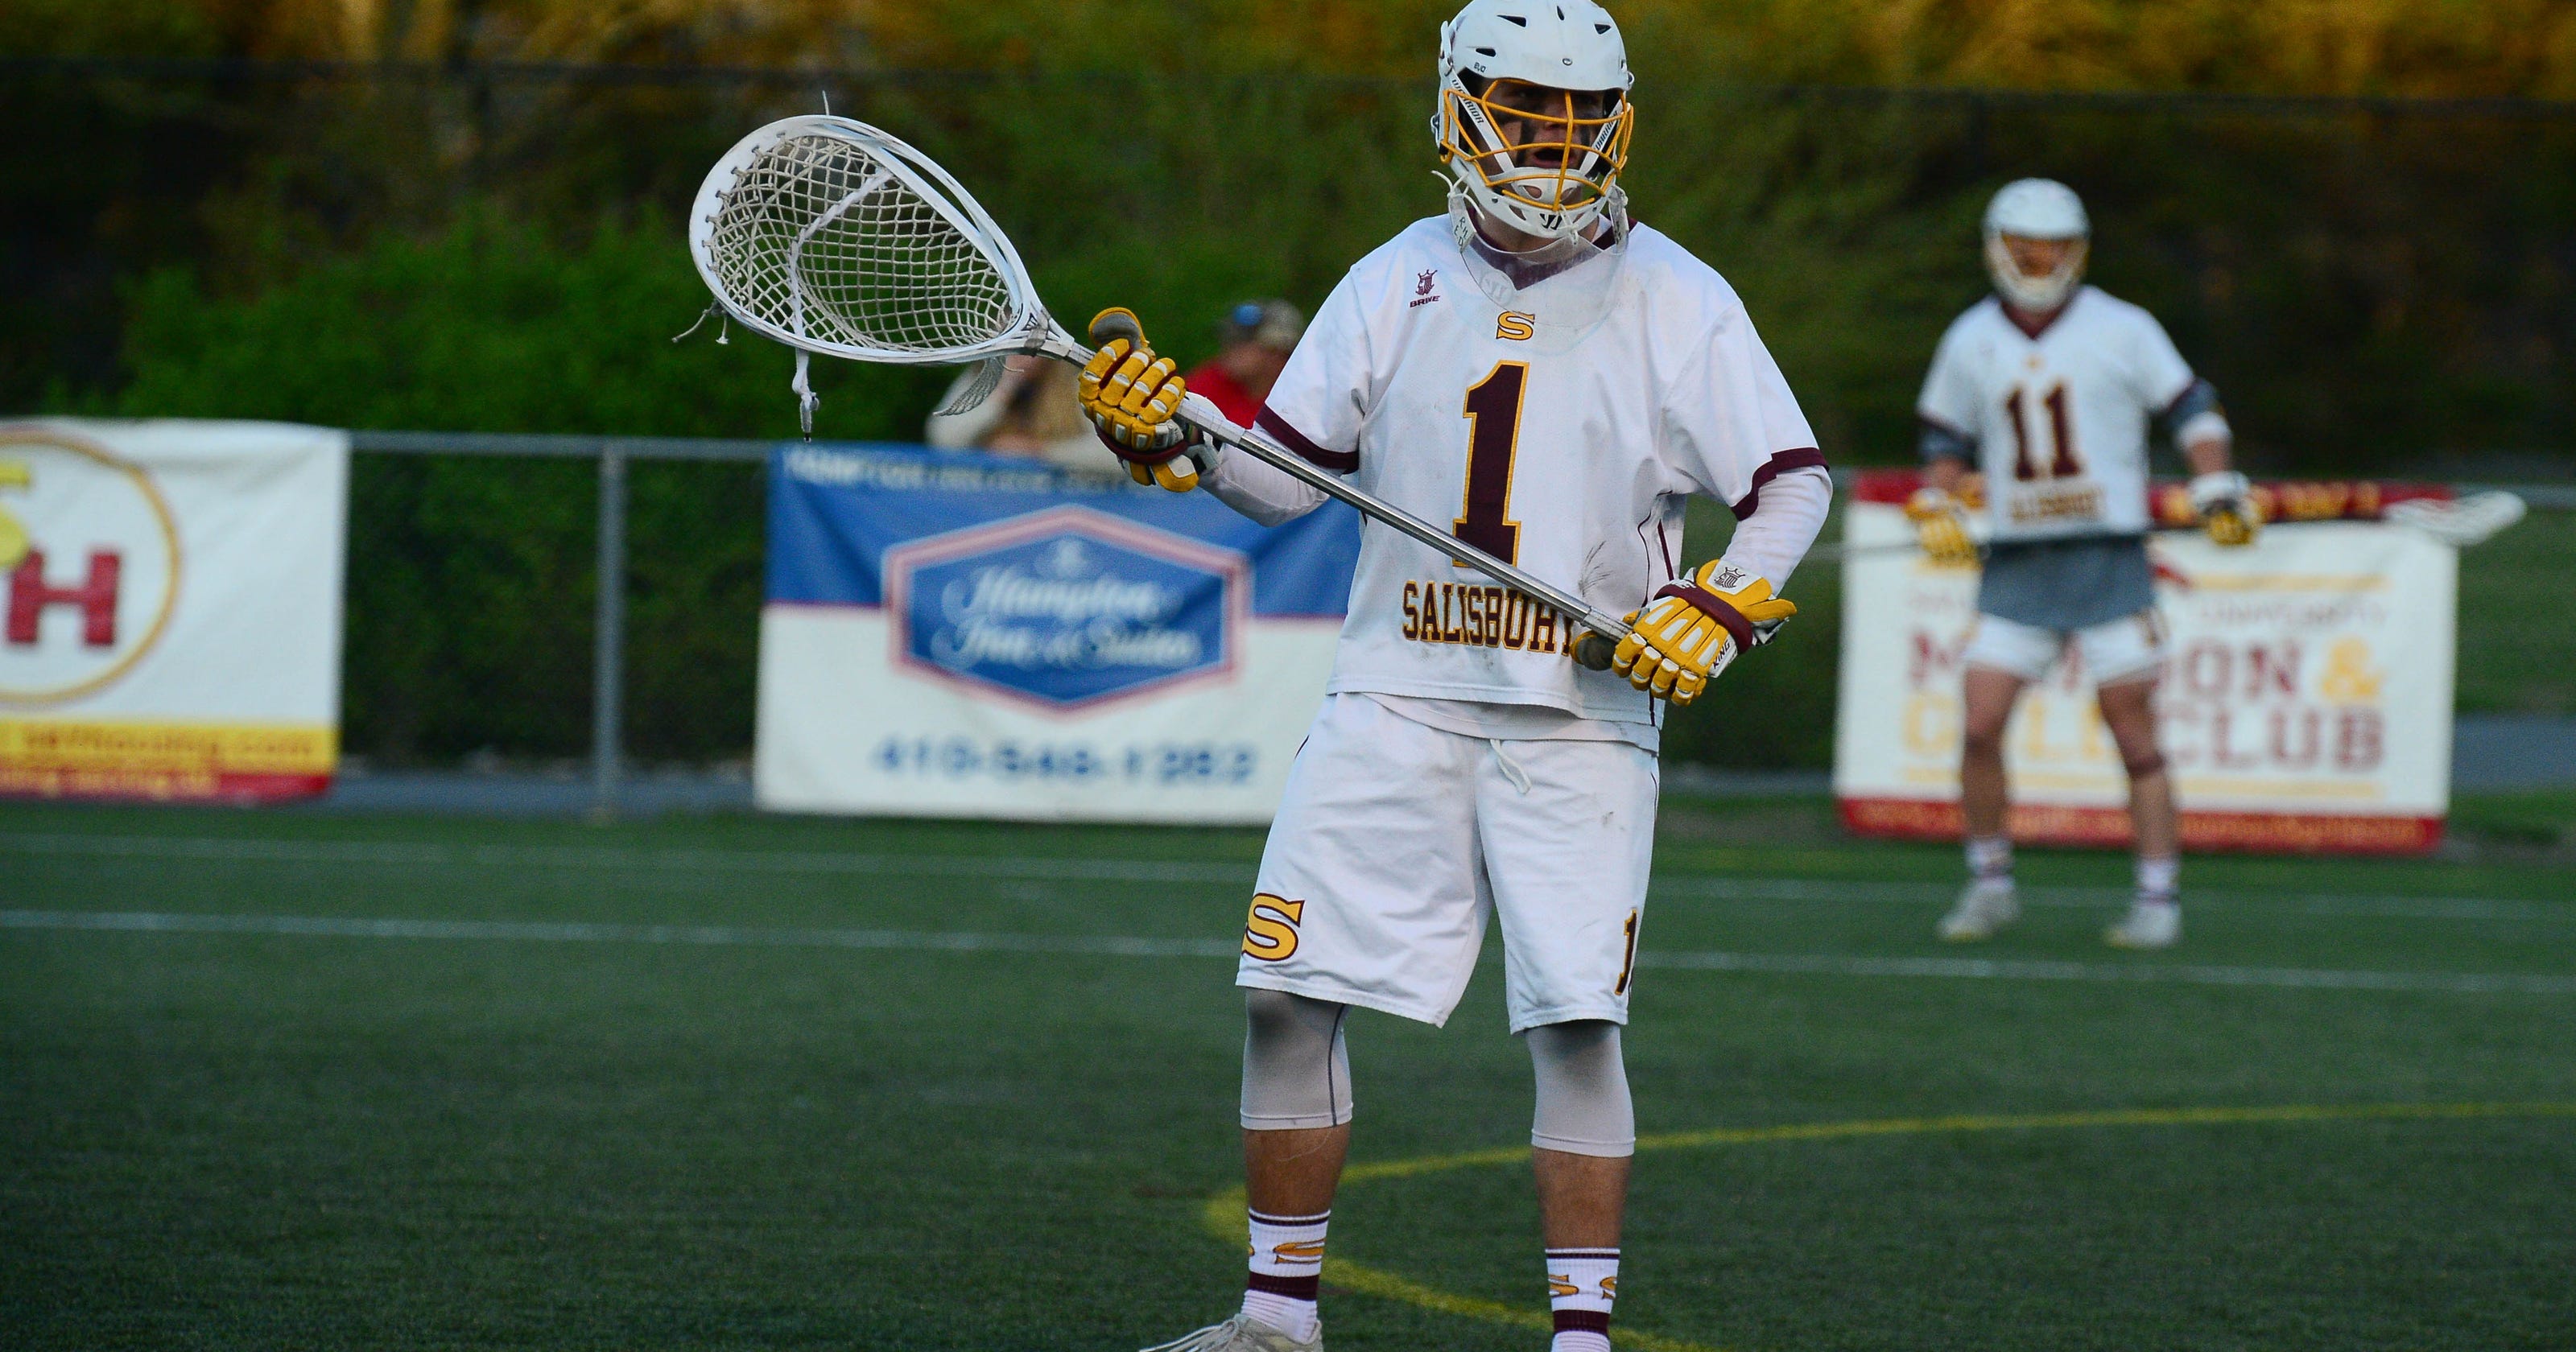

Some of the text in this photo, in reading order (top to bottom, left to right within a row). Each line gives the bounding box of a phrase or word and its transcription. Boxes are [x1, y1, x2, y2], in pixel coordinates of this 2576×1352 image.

[1496, 311, 1535, 341] S
[1452, 360, 1530, 567] 1
[2004, 380, 2083, 480] 11
[1712, 638, 1731, 670] KING
[2320, 636, 2388, 704] &
[1241, 892, 1305, 961] S
